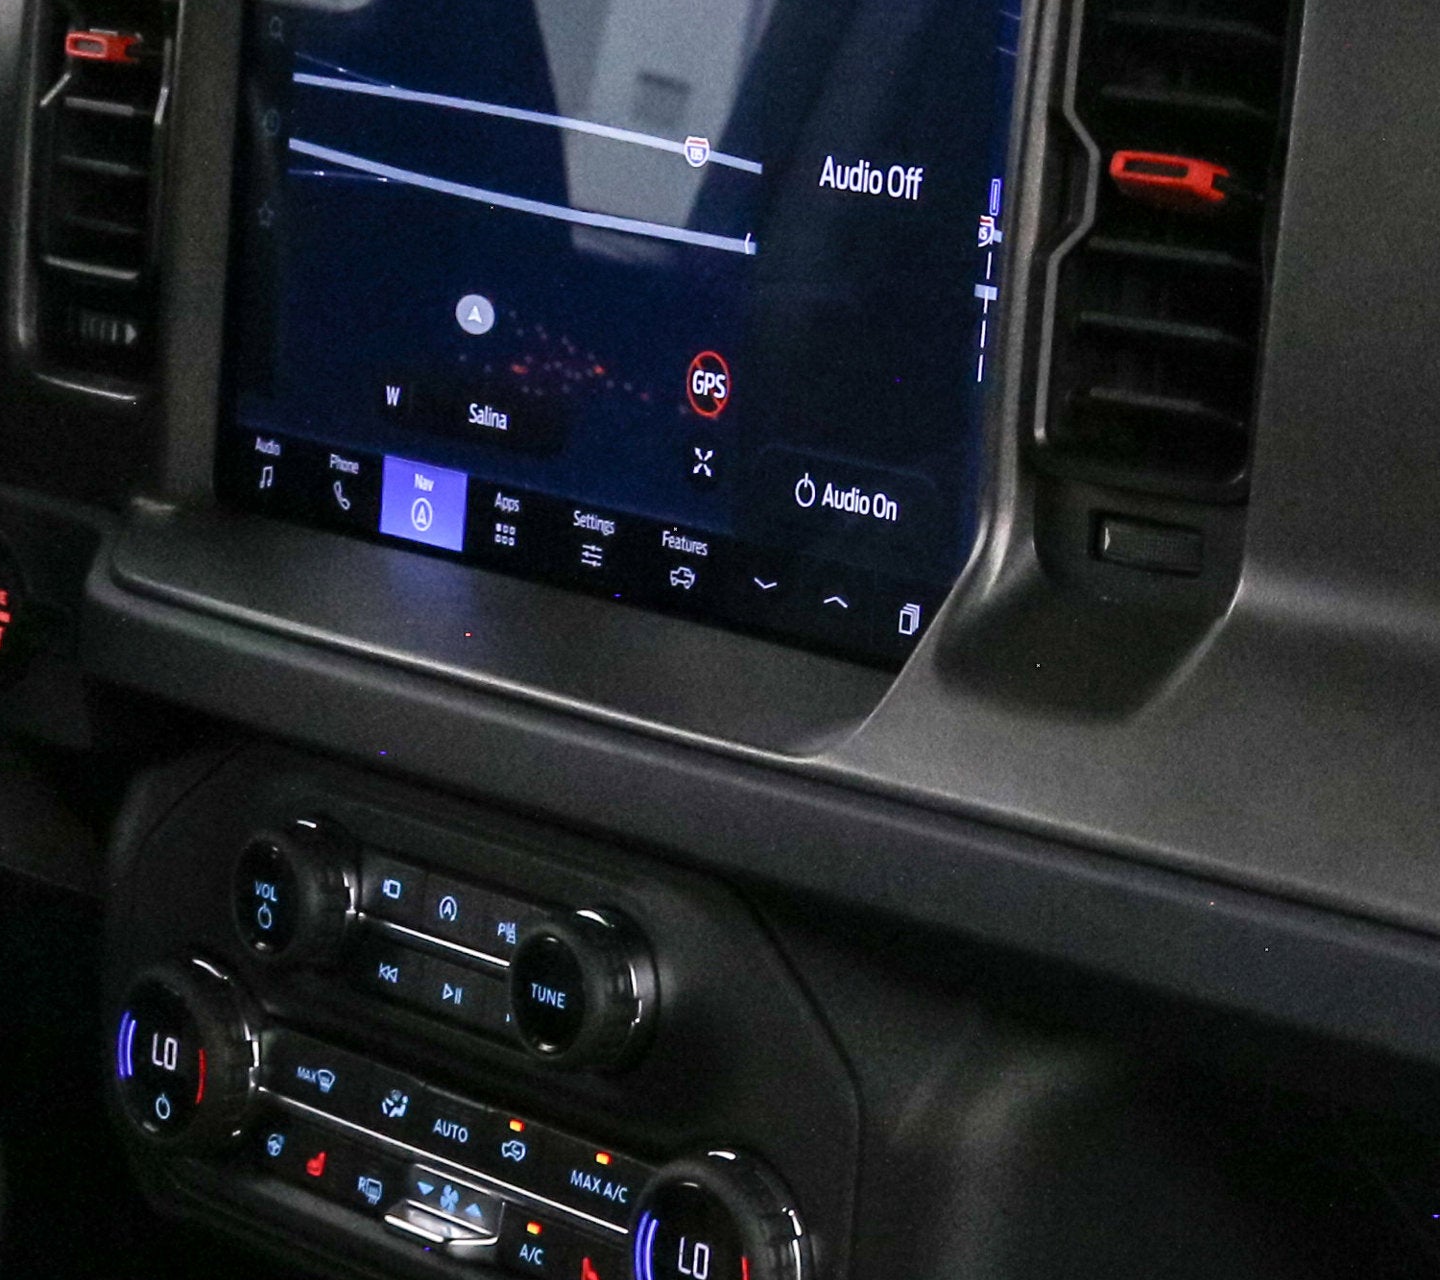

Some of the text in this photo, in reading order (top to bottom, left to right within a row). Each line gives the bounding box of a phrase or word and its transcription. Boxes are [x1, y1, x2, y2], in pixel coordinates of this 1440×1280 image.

[819, 155, 924, 201] Audio Off
[386, 385, 401, 407] W
[692, 370, 728, 399] GPS
[468, 403, 508, 431] Salina
[255, 436, 281, 456] Audio
[330, 453, 359, 475] Phone
[414, 473, 435, 492] Nav
[494, 492, 521, 514] Apps
[821, 482, 898, 522] Audio On
[573, 510, 616, 536] Settings
[662, 531, 709, 557] Features
[254, 881, 279, 903] VOL
[531, 982, 566, 1009] TUNE
[152, 1032, 178, 1070] LO
[432, 1118, 469, 1143] AUTO
[570, 1169, 628, 1205] MAX A/C
[519, 1243, 544, 1266] A/C
[678, 1237, 710, 1280] LO
